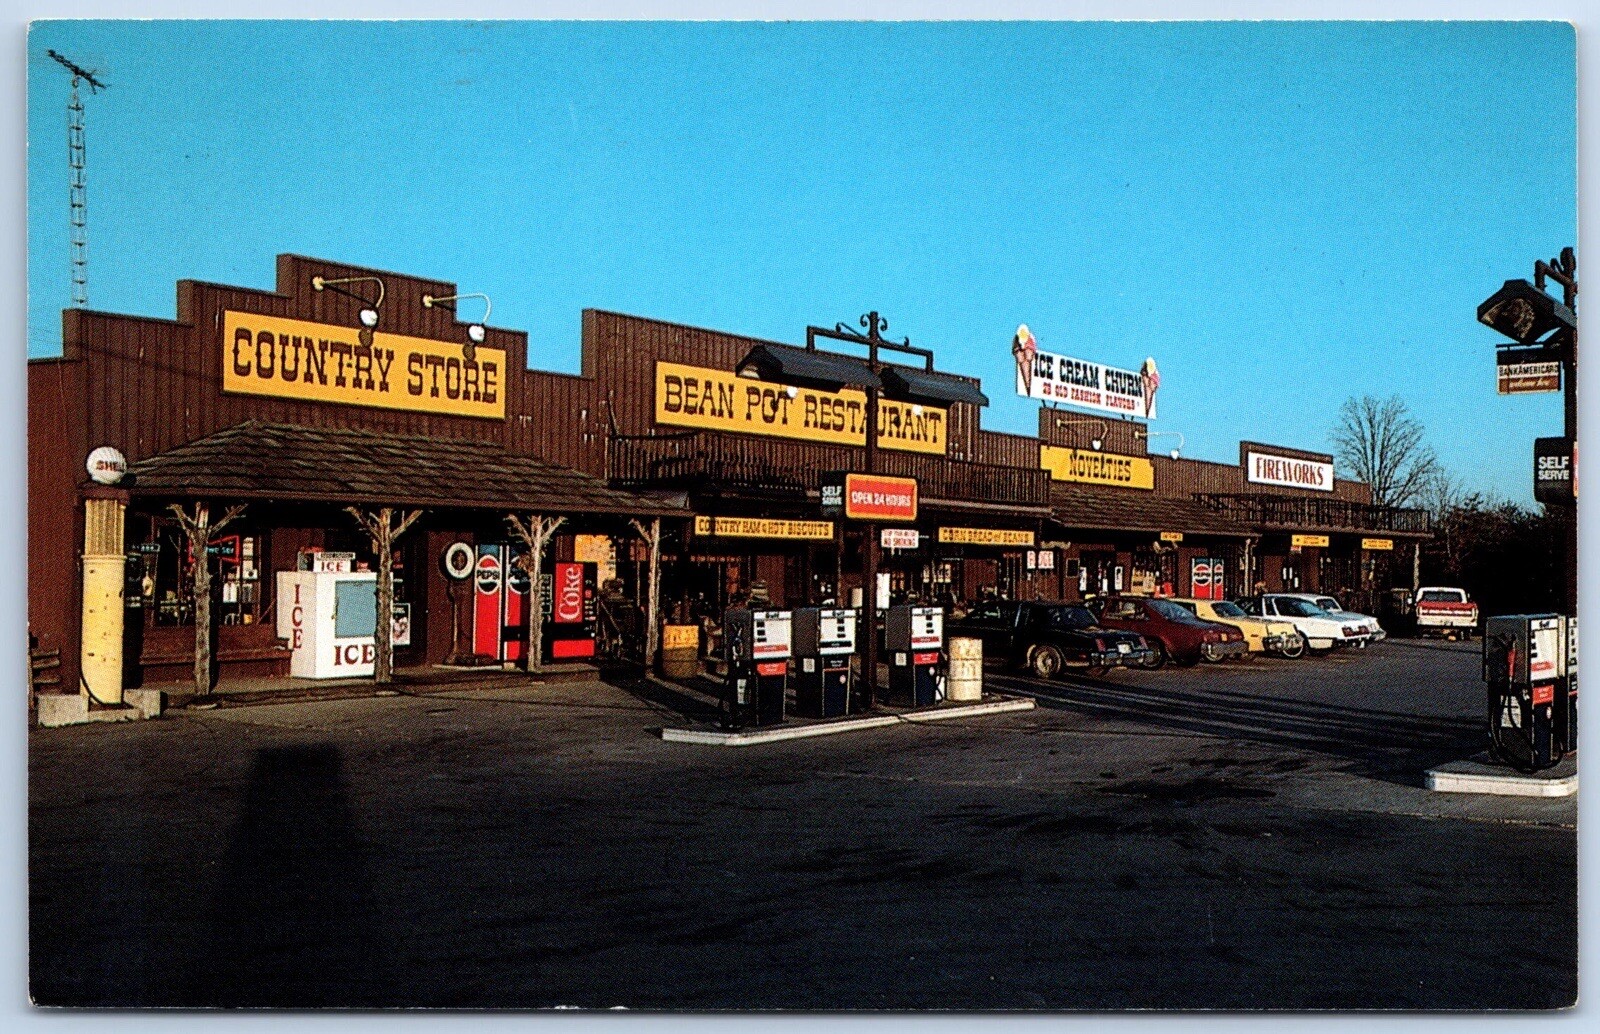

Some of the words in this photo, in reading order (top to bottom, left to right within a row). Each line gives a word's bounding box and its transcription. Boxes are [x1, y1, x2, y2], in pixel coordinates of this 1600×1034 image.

[233, 326, 395, 394] COUNTRY
[407, 351, 498, 404] STORE
[1034, 352, 1054, 380] ICE
[1059, 357, 1100, 389] CREAM
[1105, 368, 1143, 398] CHURN
[664, 375, 734, 419] BEAN
[746, 386, 794, 425] POT
[1069, 452, 1132, 482] NOVELTIES
[1256, 457, 1325, 486] FIREWORKS
[1538, 456, 1569, 469] SELF
[1538, 470, 1569, 480] SERVE
[822, 486, 842, 497] SELF
[851, 491, 873, 504] OPEN
[873, 493, 885, 505] 24
[885, 494, 911, 507] HOURS
[698, 517, 740, 533] CONTRY
[787, 522, 829, 536] BISCUITS
[321, 561, 343, 572] ICE
[477, 570, 500, 580] PEPSI
[558, 567, 581, 620] Coke
[291, 584, 303, 649] ICE
[334, 644, 375, 666] ICE
